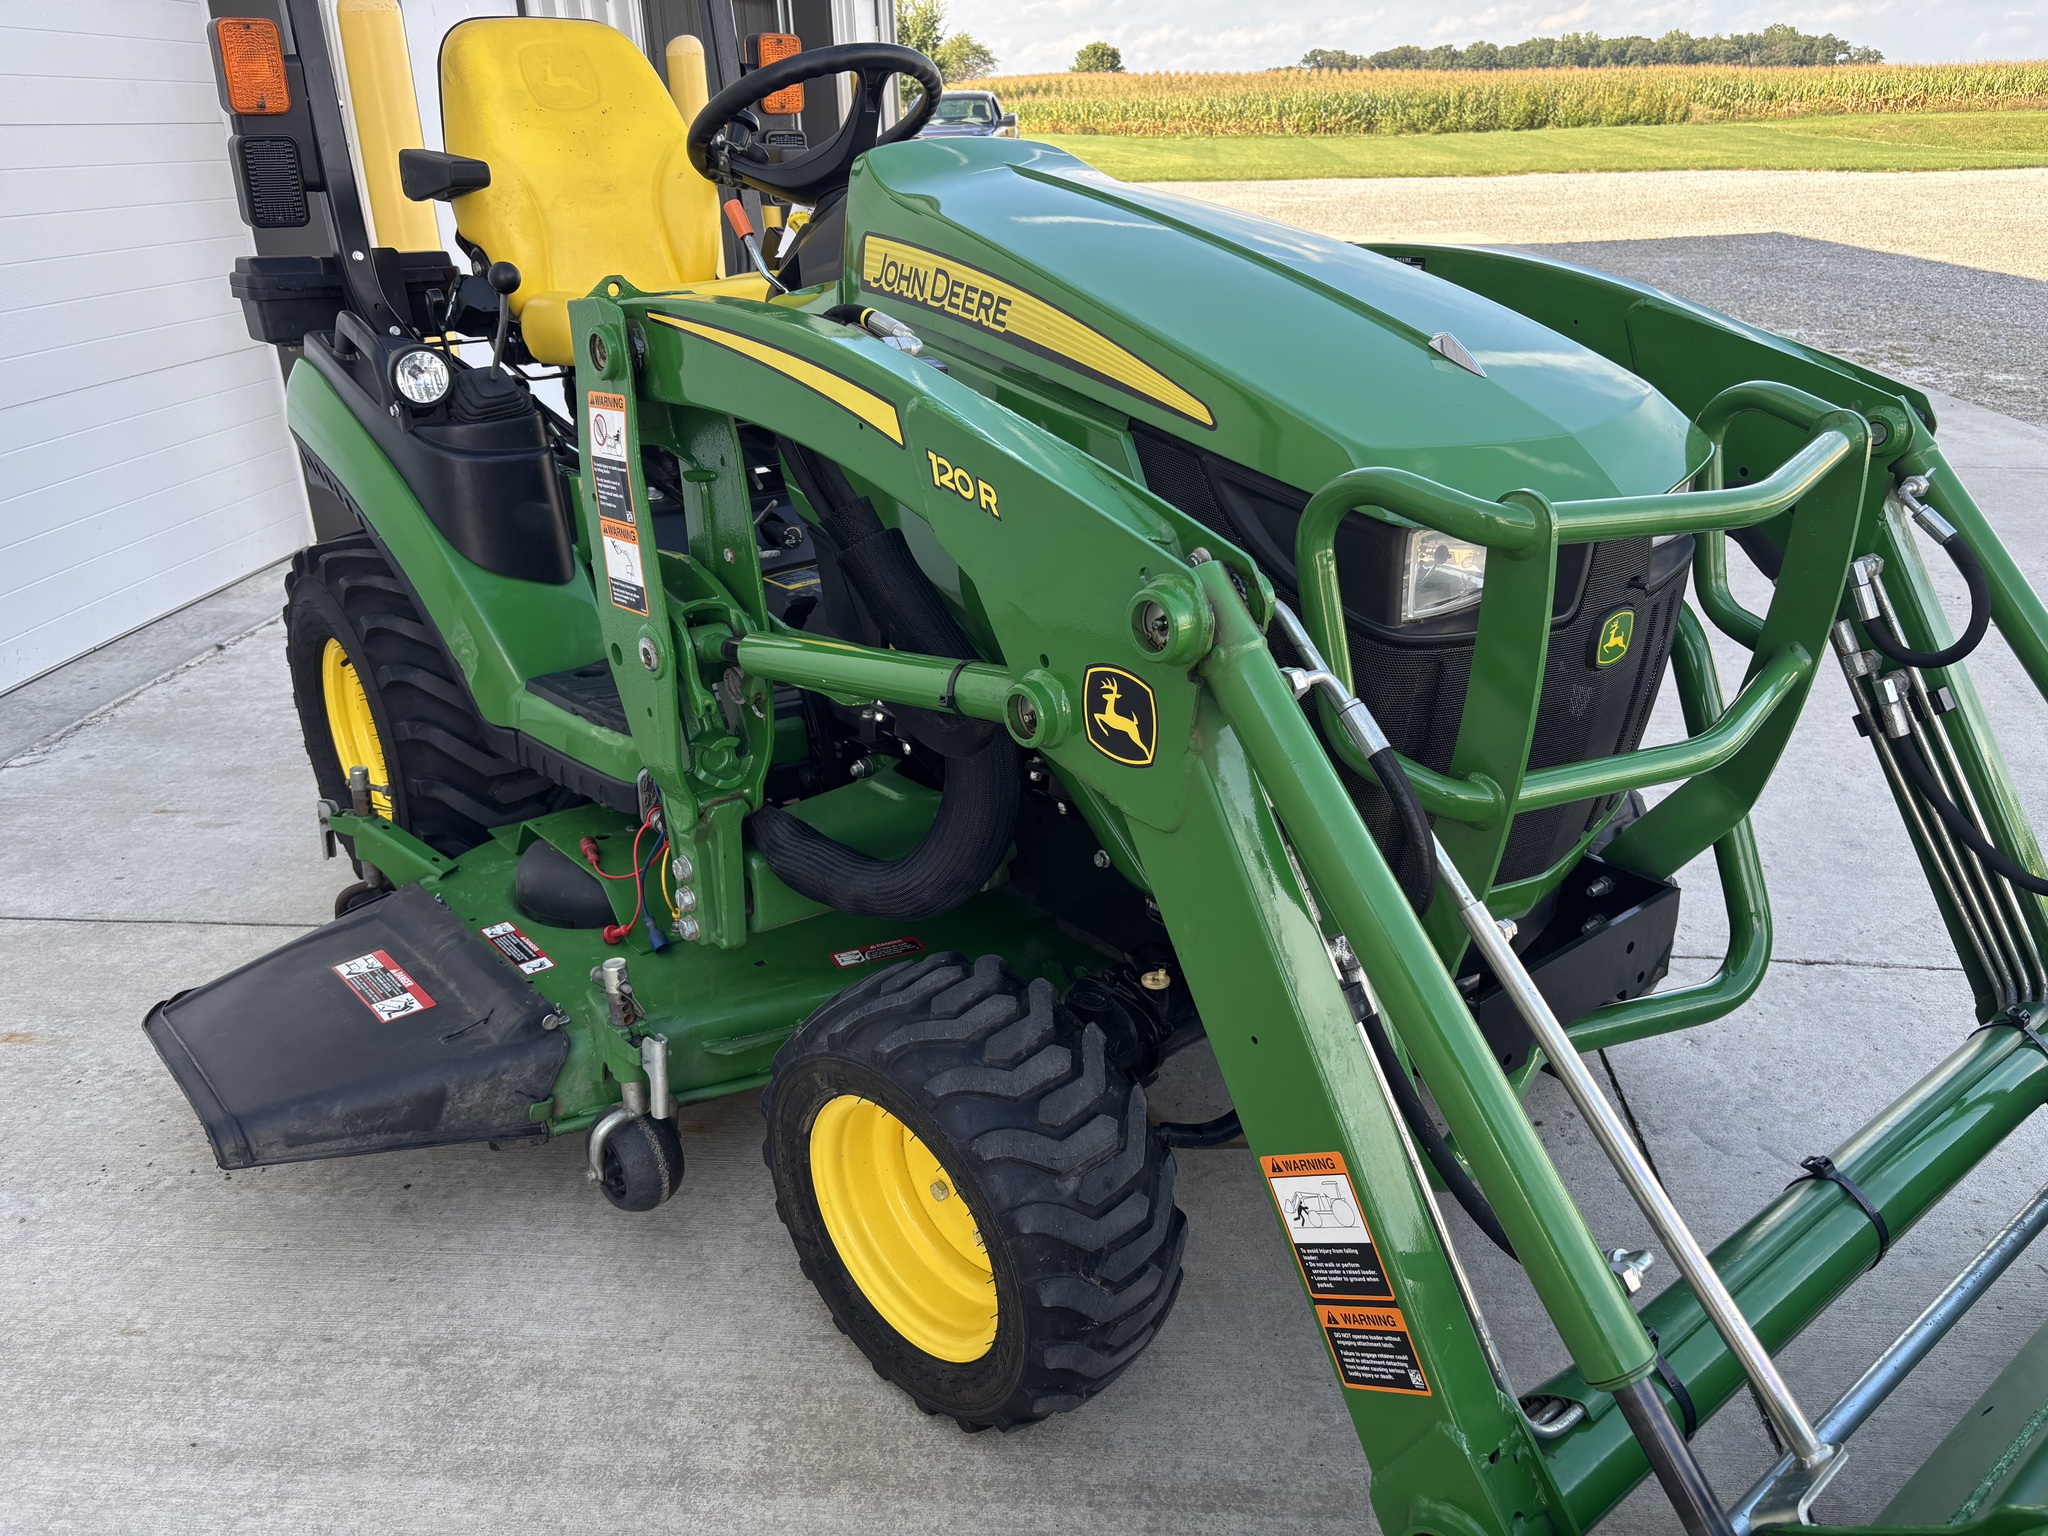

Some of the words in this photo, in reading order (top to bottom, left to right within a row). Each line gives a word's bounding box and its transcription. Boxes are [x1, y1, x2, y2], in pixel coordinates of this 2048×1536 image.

[872, 252, 928, 298] JOHN
[929, 267, 1013, 329] DEERE
[594, 394, 624, 409] WARNING
[607, 525, 636, 542] WARNING
[522, 938, 540, 951] DANGER
[876, 940, 902, 948] DANGER
[392, 970, 414, 987] DANGER
[1282, 1157, 1336, 1172] WARNING
[1340, 1313, 1397, 1327] WARNING
